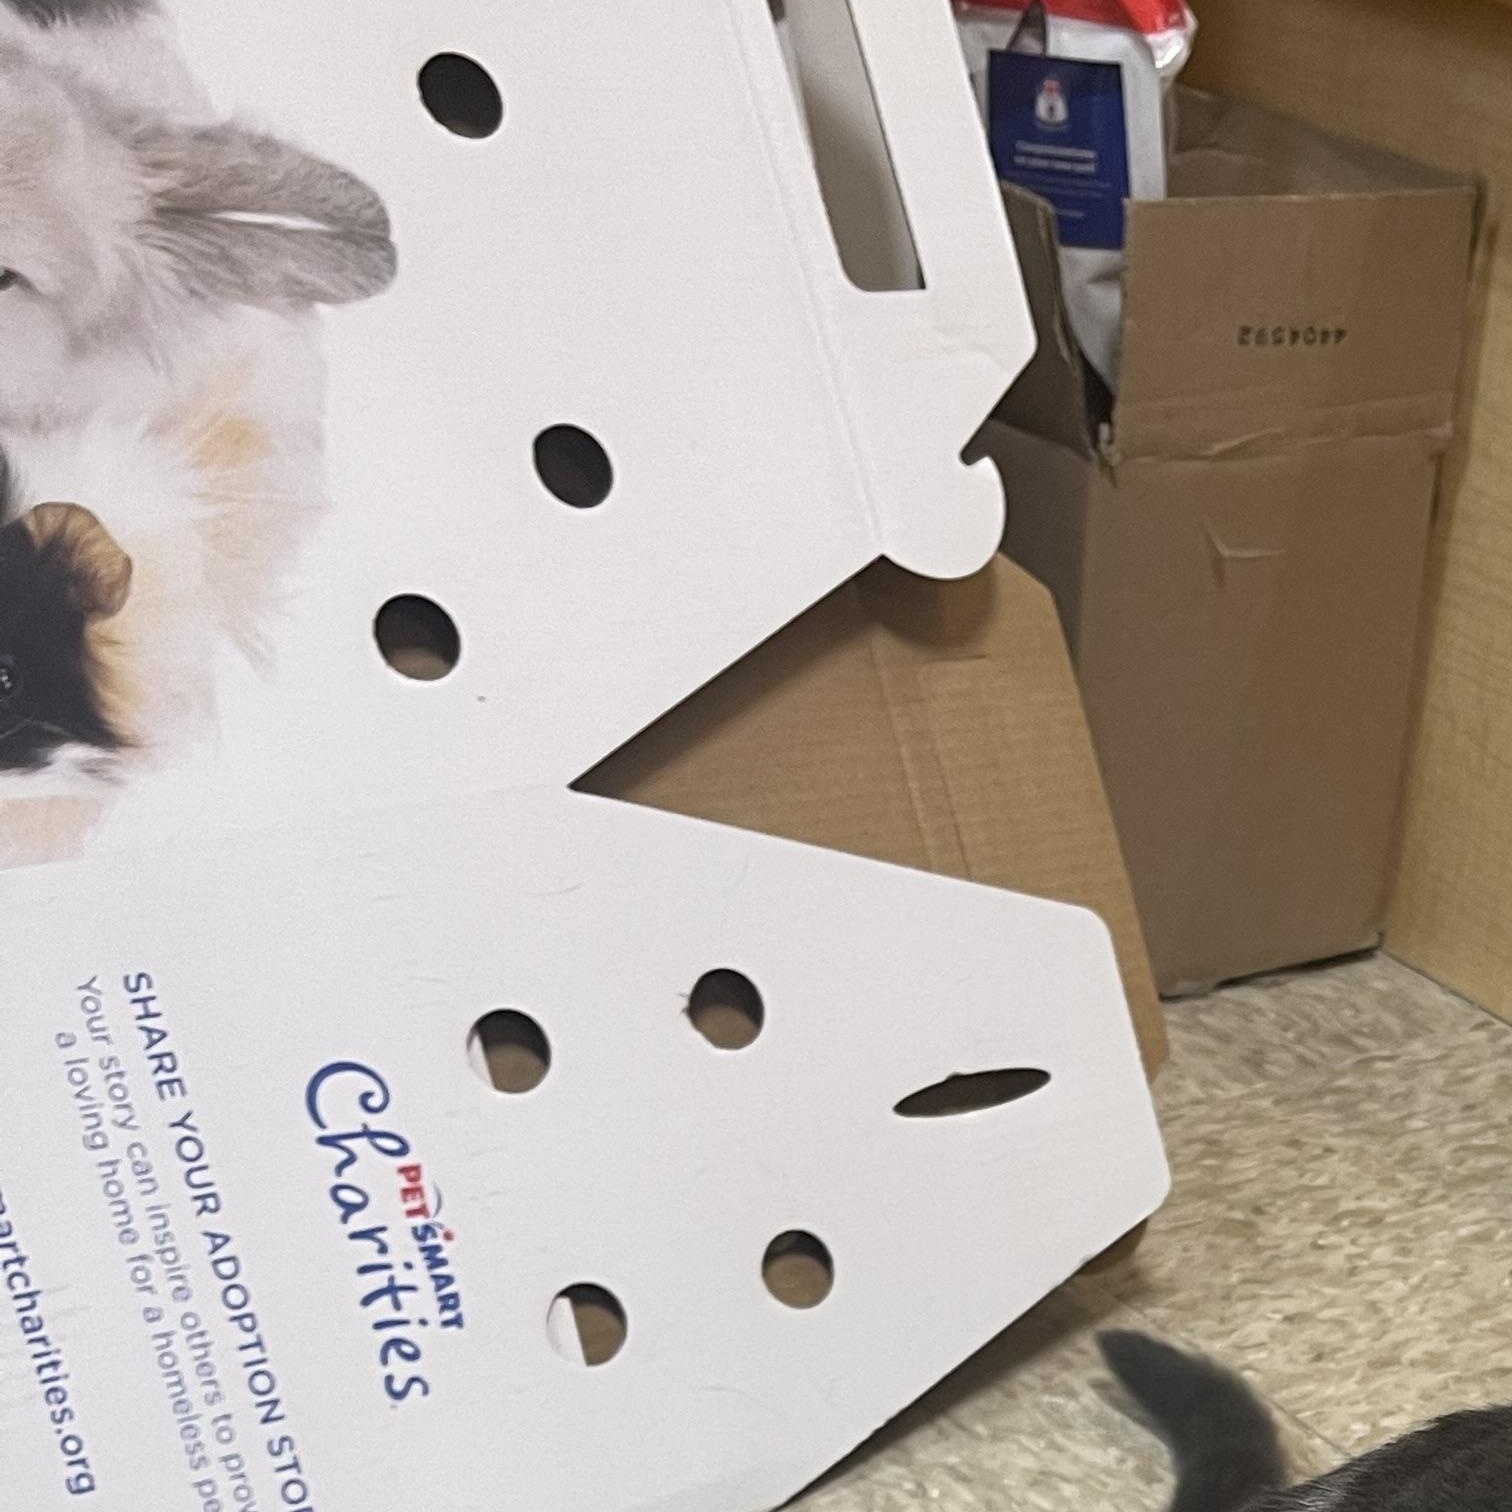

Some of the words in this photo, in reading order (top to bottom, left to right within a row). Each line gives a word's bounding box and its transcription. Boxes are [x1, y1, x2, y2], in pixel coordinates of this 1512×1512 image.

[55, 1032, 76, 1049] a
[64, 1058, 109, 1151] loving
[77, 976, 113, 1045] Your
[99, 1056, 140, 1130] story
[127, 1142, 159, 1196] can
[146, 1204, 192, 1302] inspire
[180, 1312, 224, 1406] others
[211, 1413, 235, 1444] to
[96, 1159, 139, 1244] home
[123, 972, 188, 1101] SHARE
[168, 1110, 222, 1217] YOUR
[200, 1231, 286, 1425] ADOPTION
[305, 1061, 430, 1402] Charities
[396, 1163, 464, 1329] PETSMART
[0, 1189, 96, 1495] artcharities.org
[126, 1254, 157, 1296] for
[143, 1307, 164, 1323] a
[152, 1330, 209, 1470] homeless
